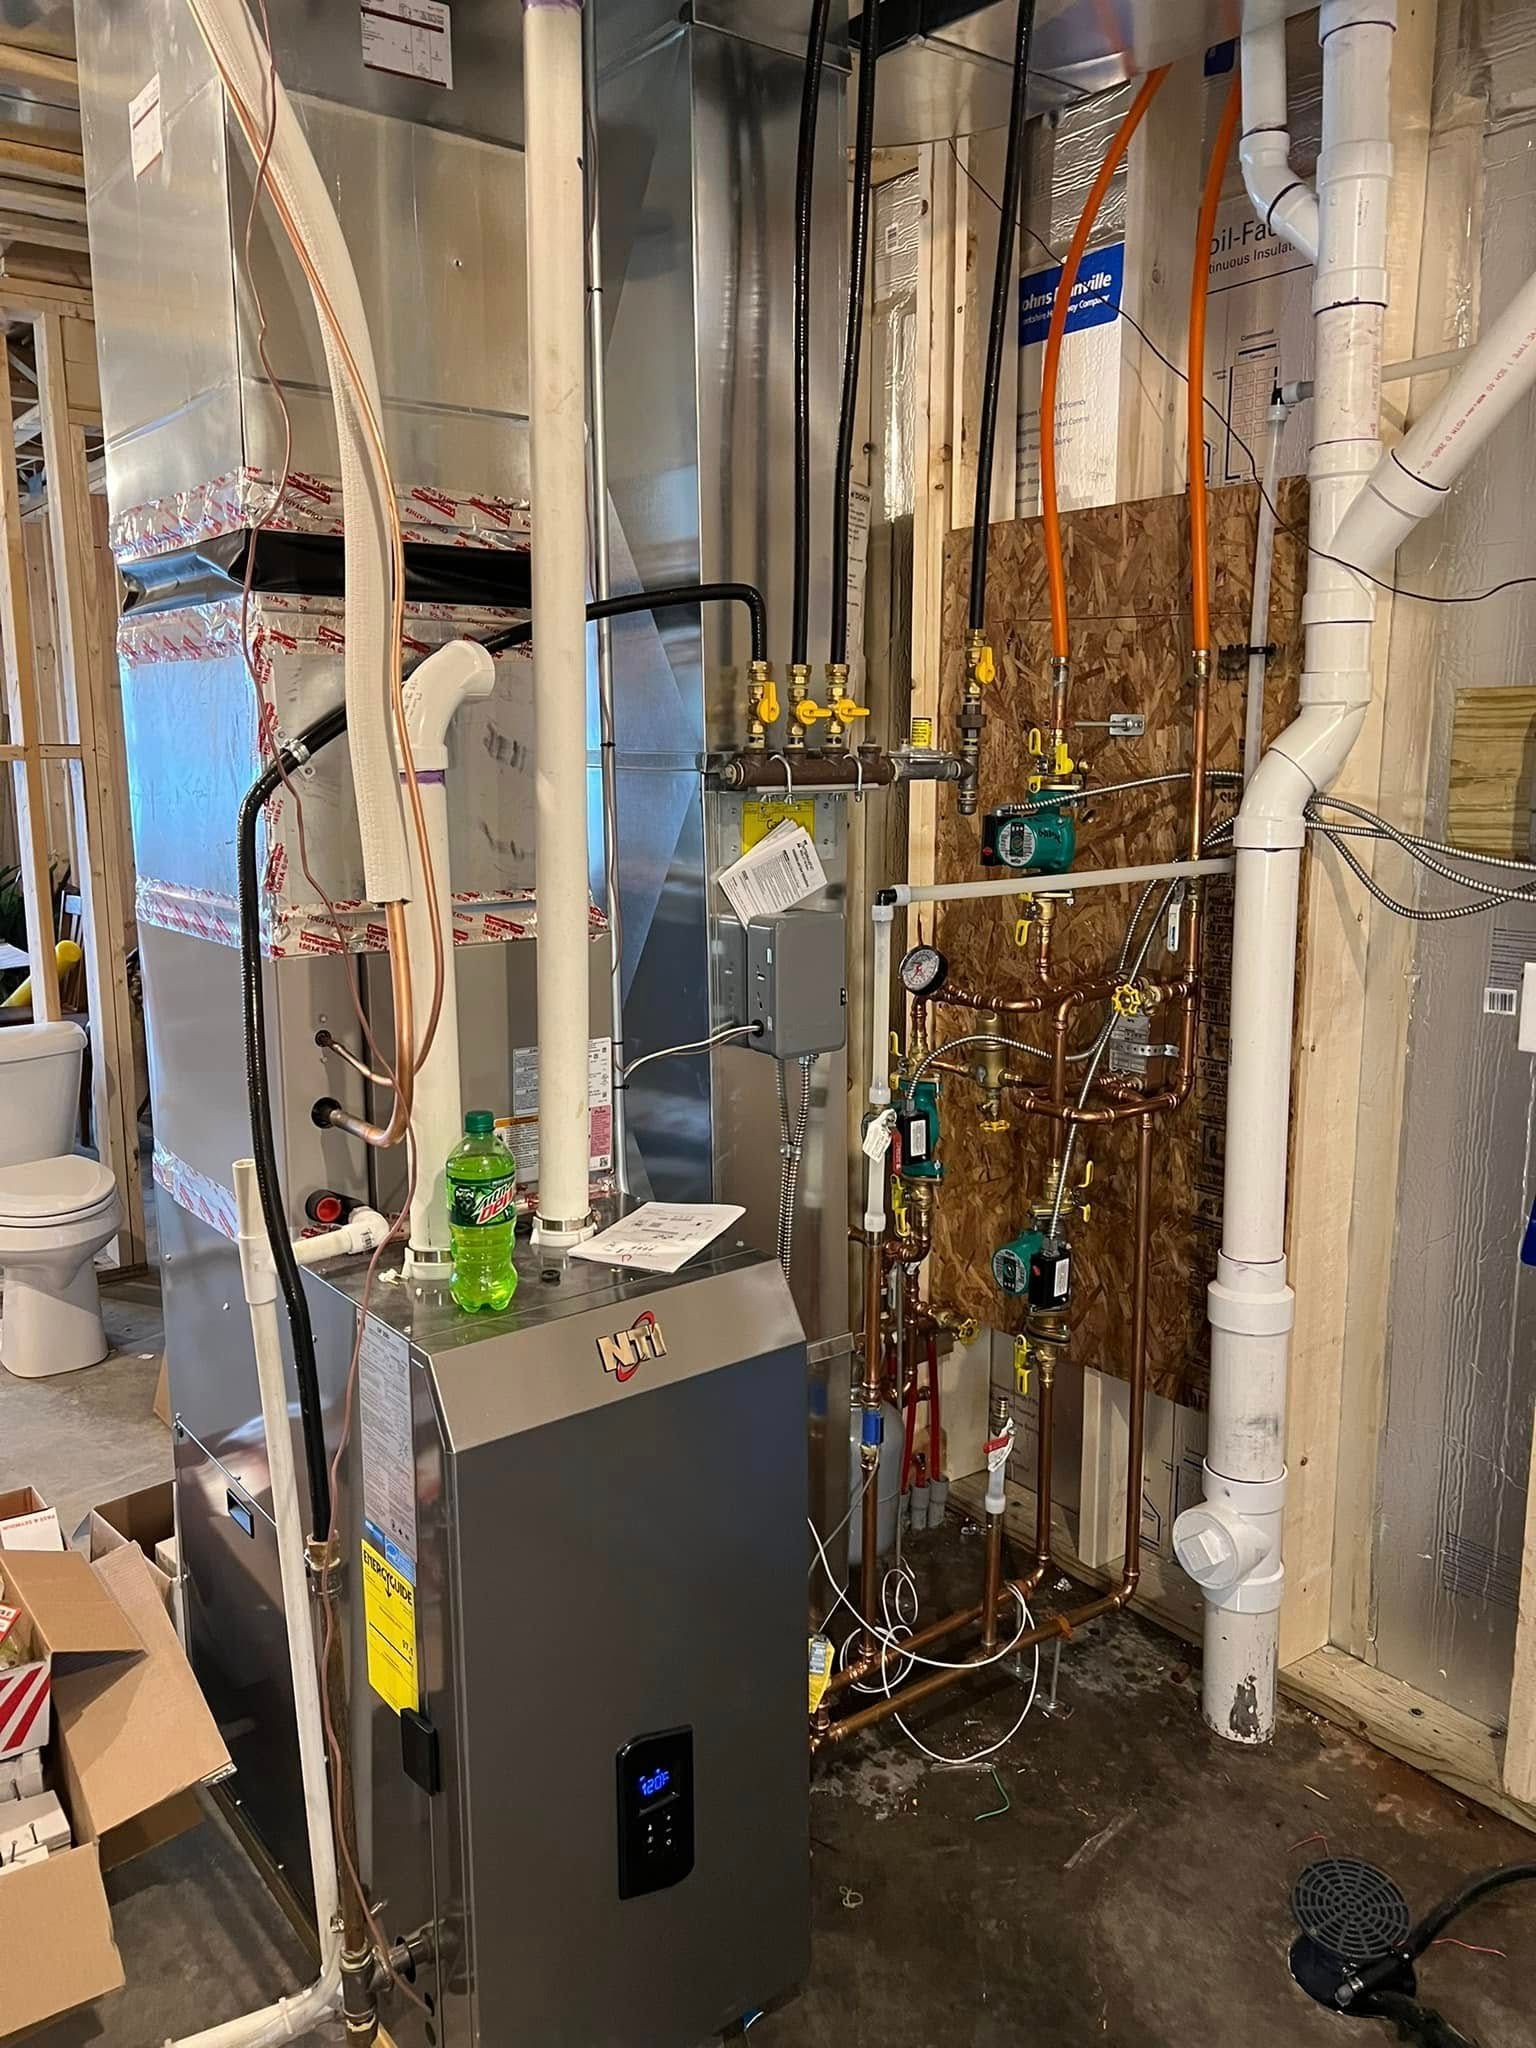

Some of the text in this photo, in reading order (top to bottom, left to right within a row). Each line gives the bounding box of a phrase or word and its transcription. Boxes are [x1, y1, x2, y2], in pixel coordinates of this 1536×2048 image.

[1208, 241, 1296, 274] tinuous Insulat
[1023, 292, 1053, 312] ohns
